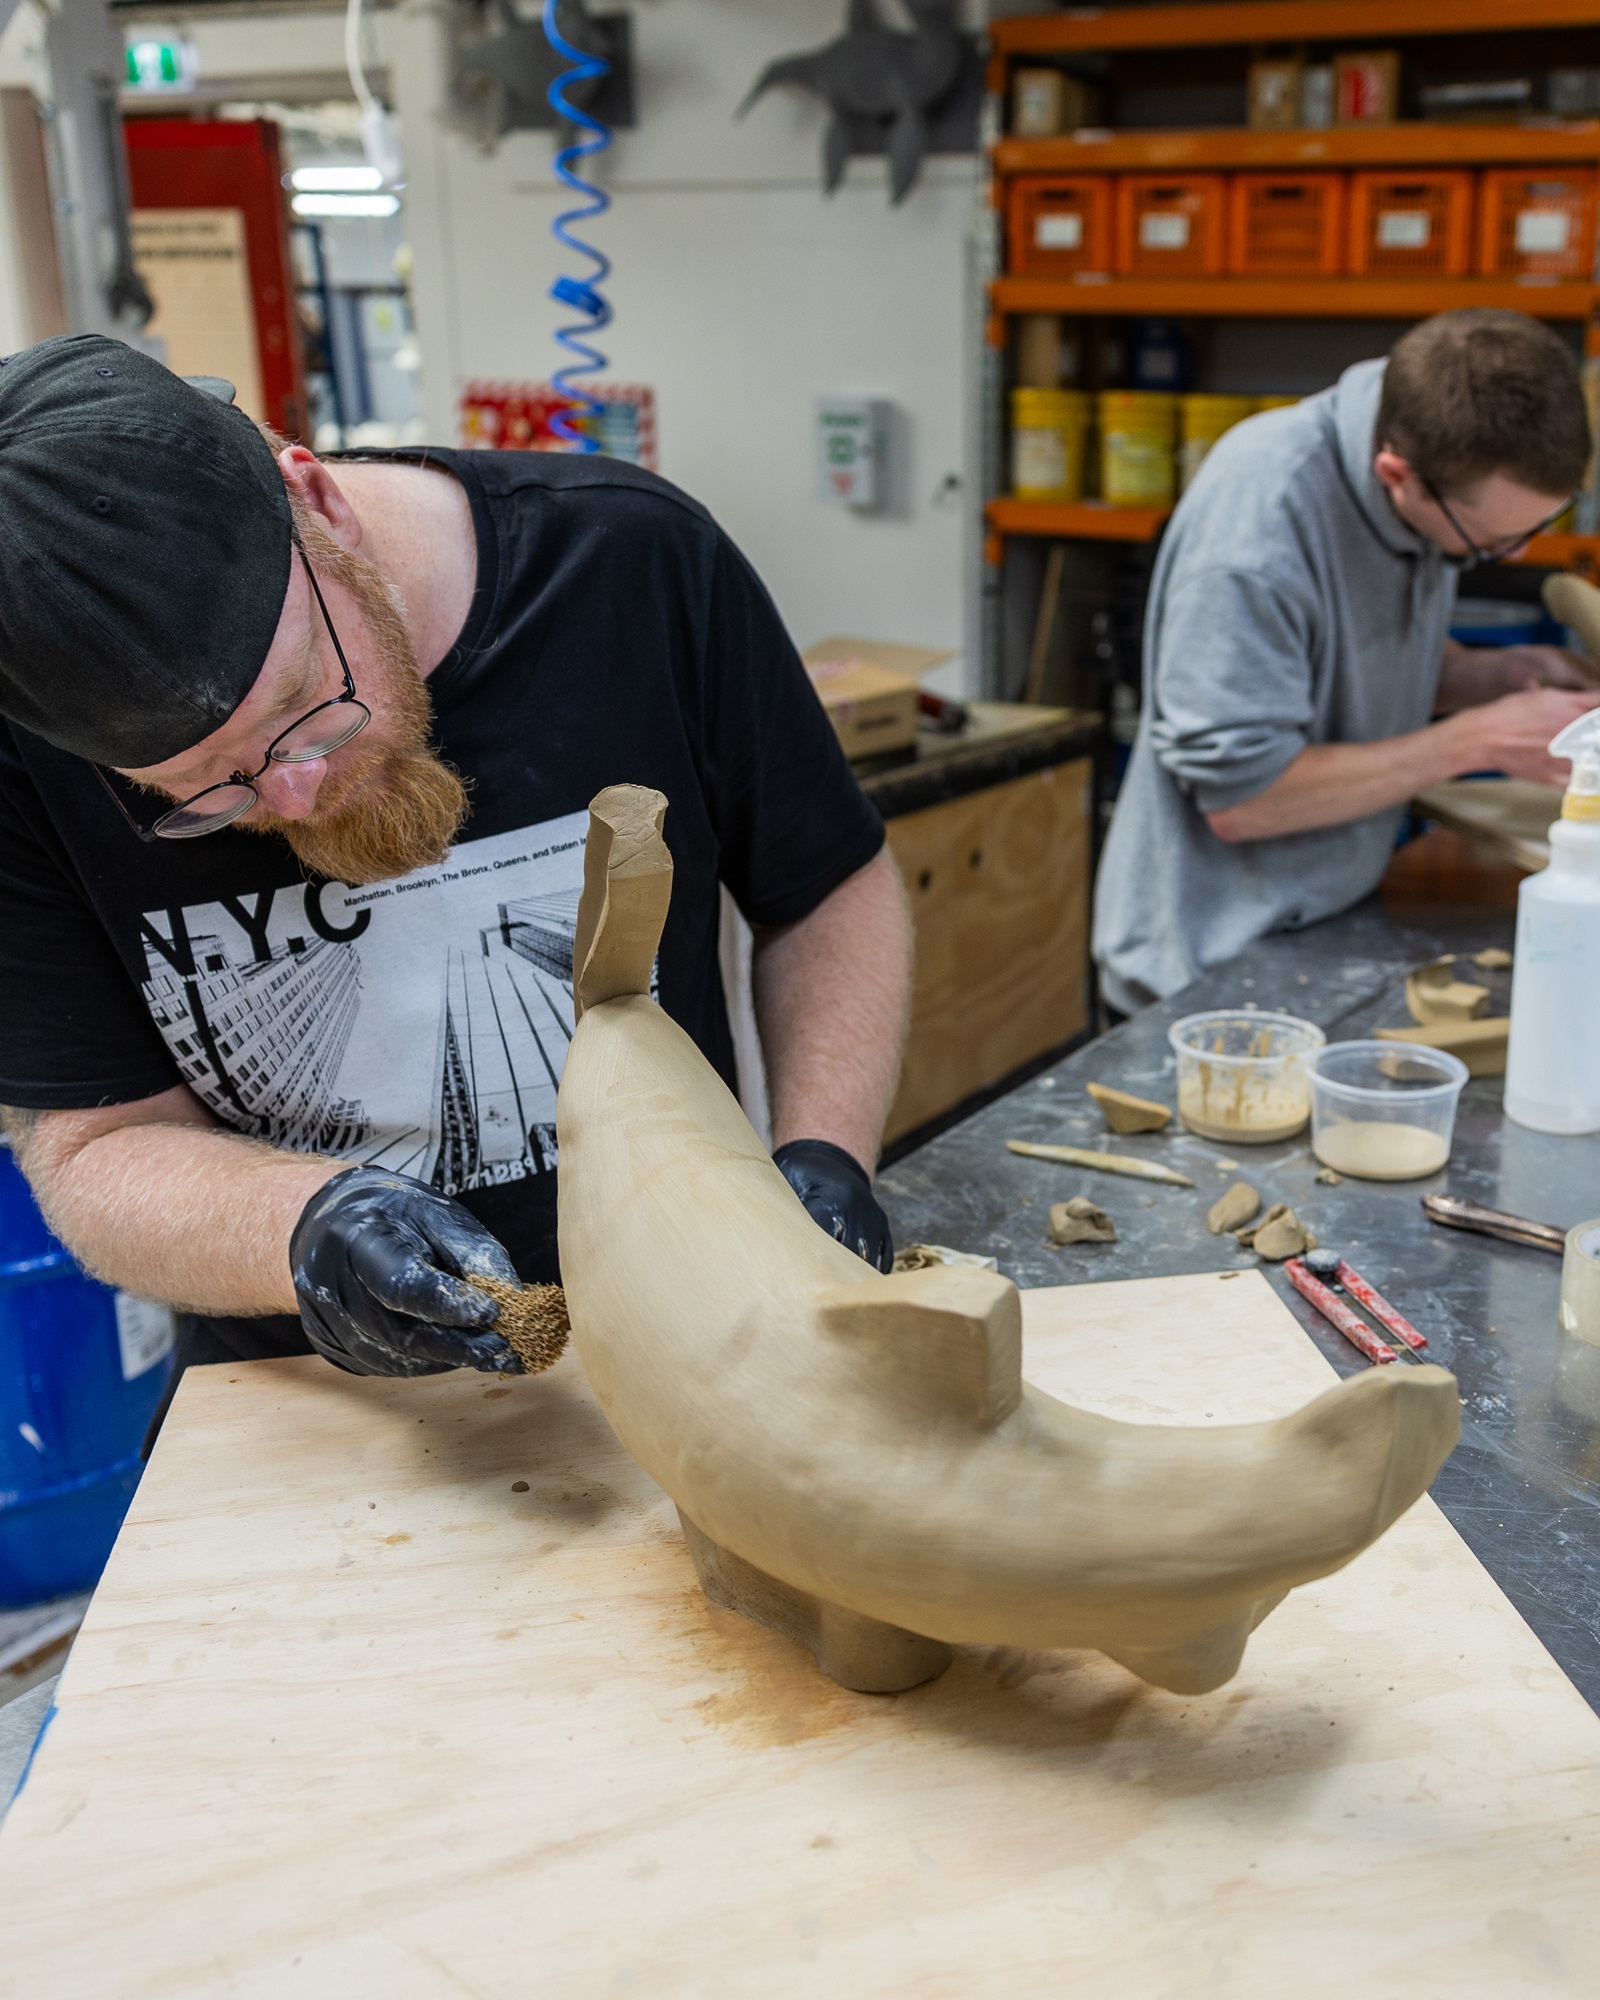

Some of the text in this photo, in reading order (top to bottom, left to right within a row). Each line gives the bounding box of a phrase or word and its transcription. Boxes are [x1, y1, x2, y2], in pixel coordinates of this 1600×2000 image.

[343, 889, 395, 907] Manhattan,
[395, 878, 441, 894] Brooklyn,
[441, 872, 459, 882] The
[460, 865, 492, 878] Bronx,
[493, 855, 531, 870] Queens,
[532, 848, 549, 860] and
[550, 840, 579, 855] Staten
